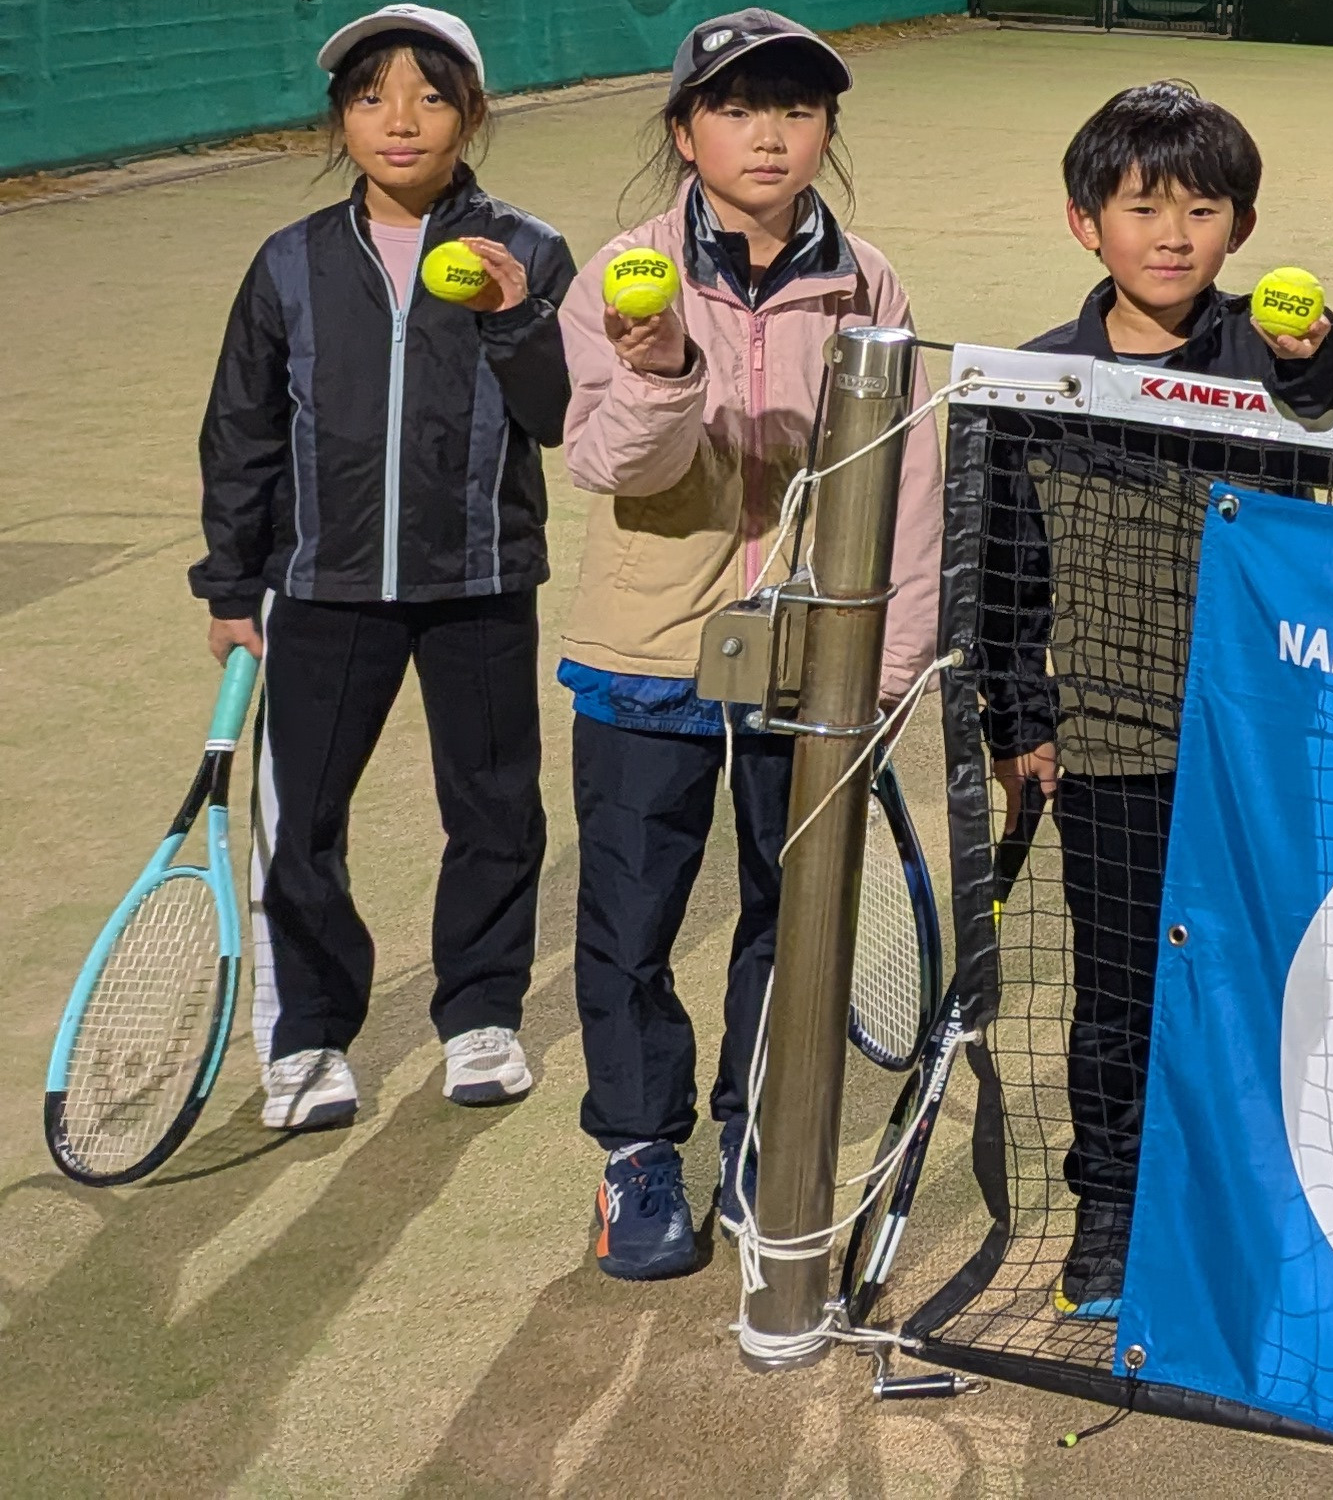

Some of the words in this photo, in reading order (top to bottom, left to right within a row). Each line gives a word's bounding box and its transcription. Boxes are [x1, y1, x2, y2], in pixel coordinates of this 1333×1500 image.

[614, 259, 669, 270] HEAD
[445, 274, 485, 287] PRO
[615, 266, 668, 281] PRO
[1264, 287, 1315, 307] HEAD
[1263, 298, 1310, 318] PRO
[1140, 377, 1267, 413] KANEYA
